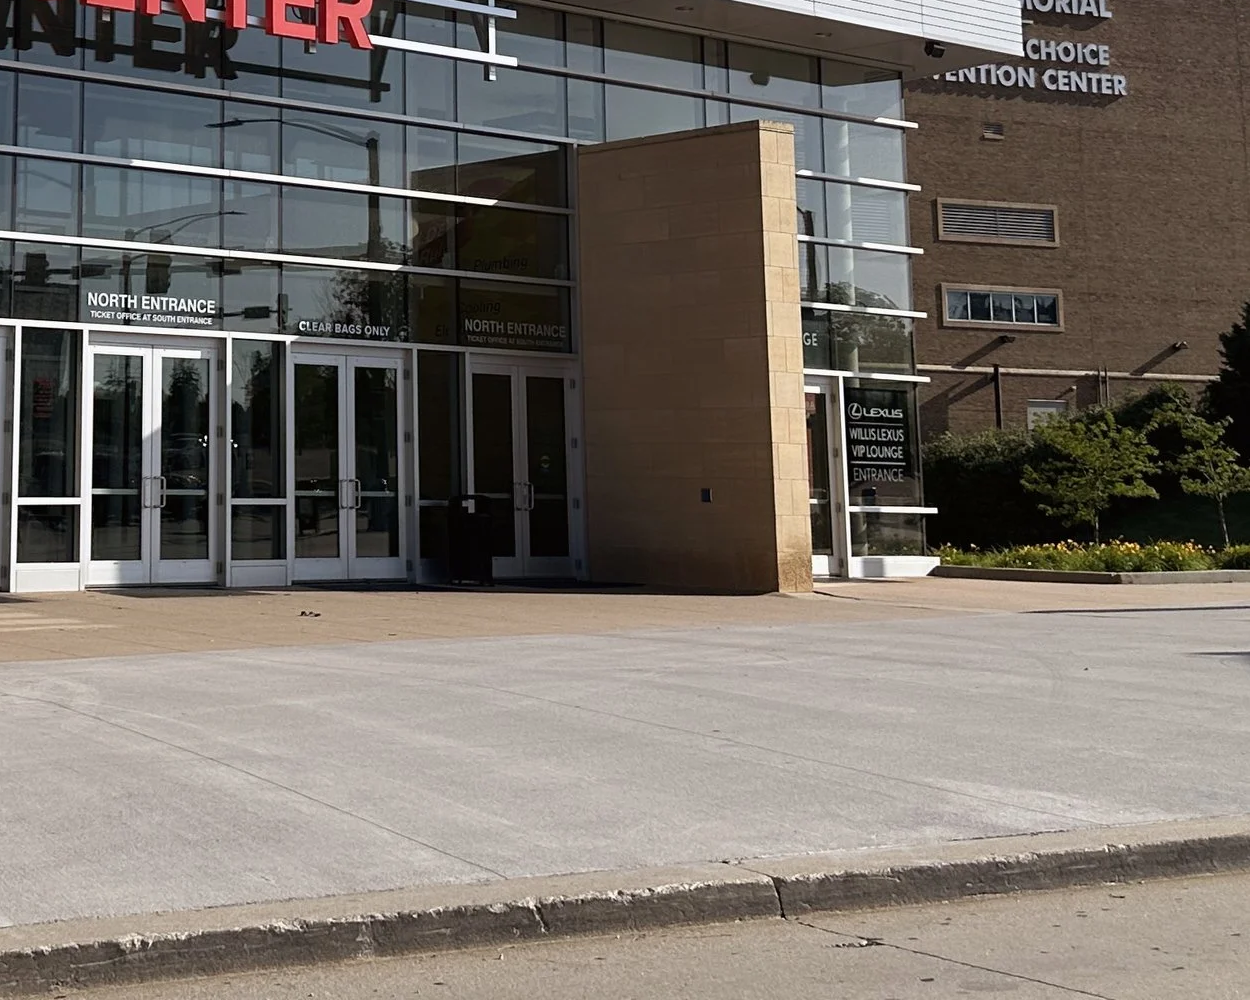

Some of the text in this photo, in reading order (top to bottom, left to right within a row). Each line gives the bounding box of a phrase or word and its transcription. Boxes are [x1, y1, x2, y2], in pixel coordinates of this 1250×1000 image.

[1026, 38, 1110, 66] CHOICE
[1042, 69, 1128, 96] CENTER
[87, 292, 216, 314] NORTH ENTRANCE
[90, 310, 213, 325] TICKET OFFICE AT SOUTH ENTRANCE
[299, 321, 390, 336] CLEAR BAGS ONLY
[464, 318, 504, 333] NORTH
[507, 321, 567, 338] ENTRANCE
[863, 407, 903, 418] LEXUS
[849, 427, 904, 442] WILLIS LEXUS
[851, 444, 904, 459] VIP LOUNGE
[853, 467, 904, 482] ENTRANCE
